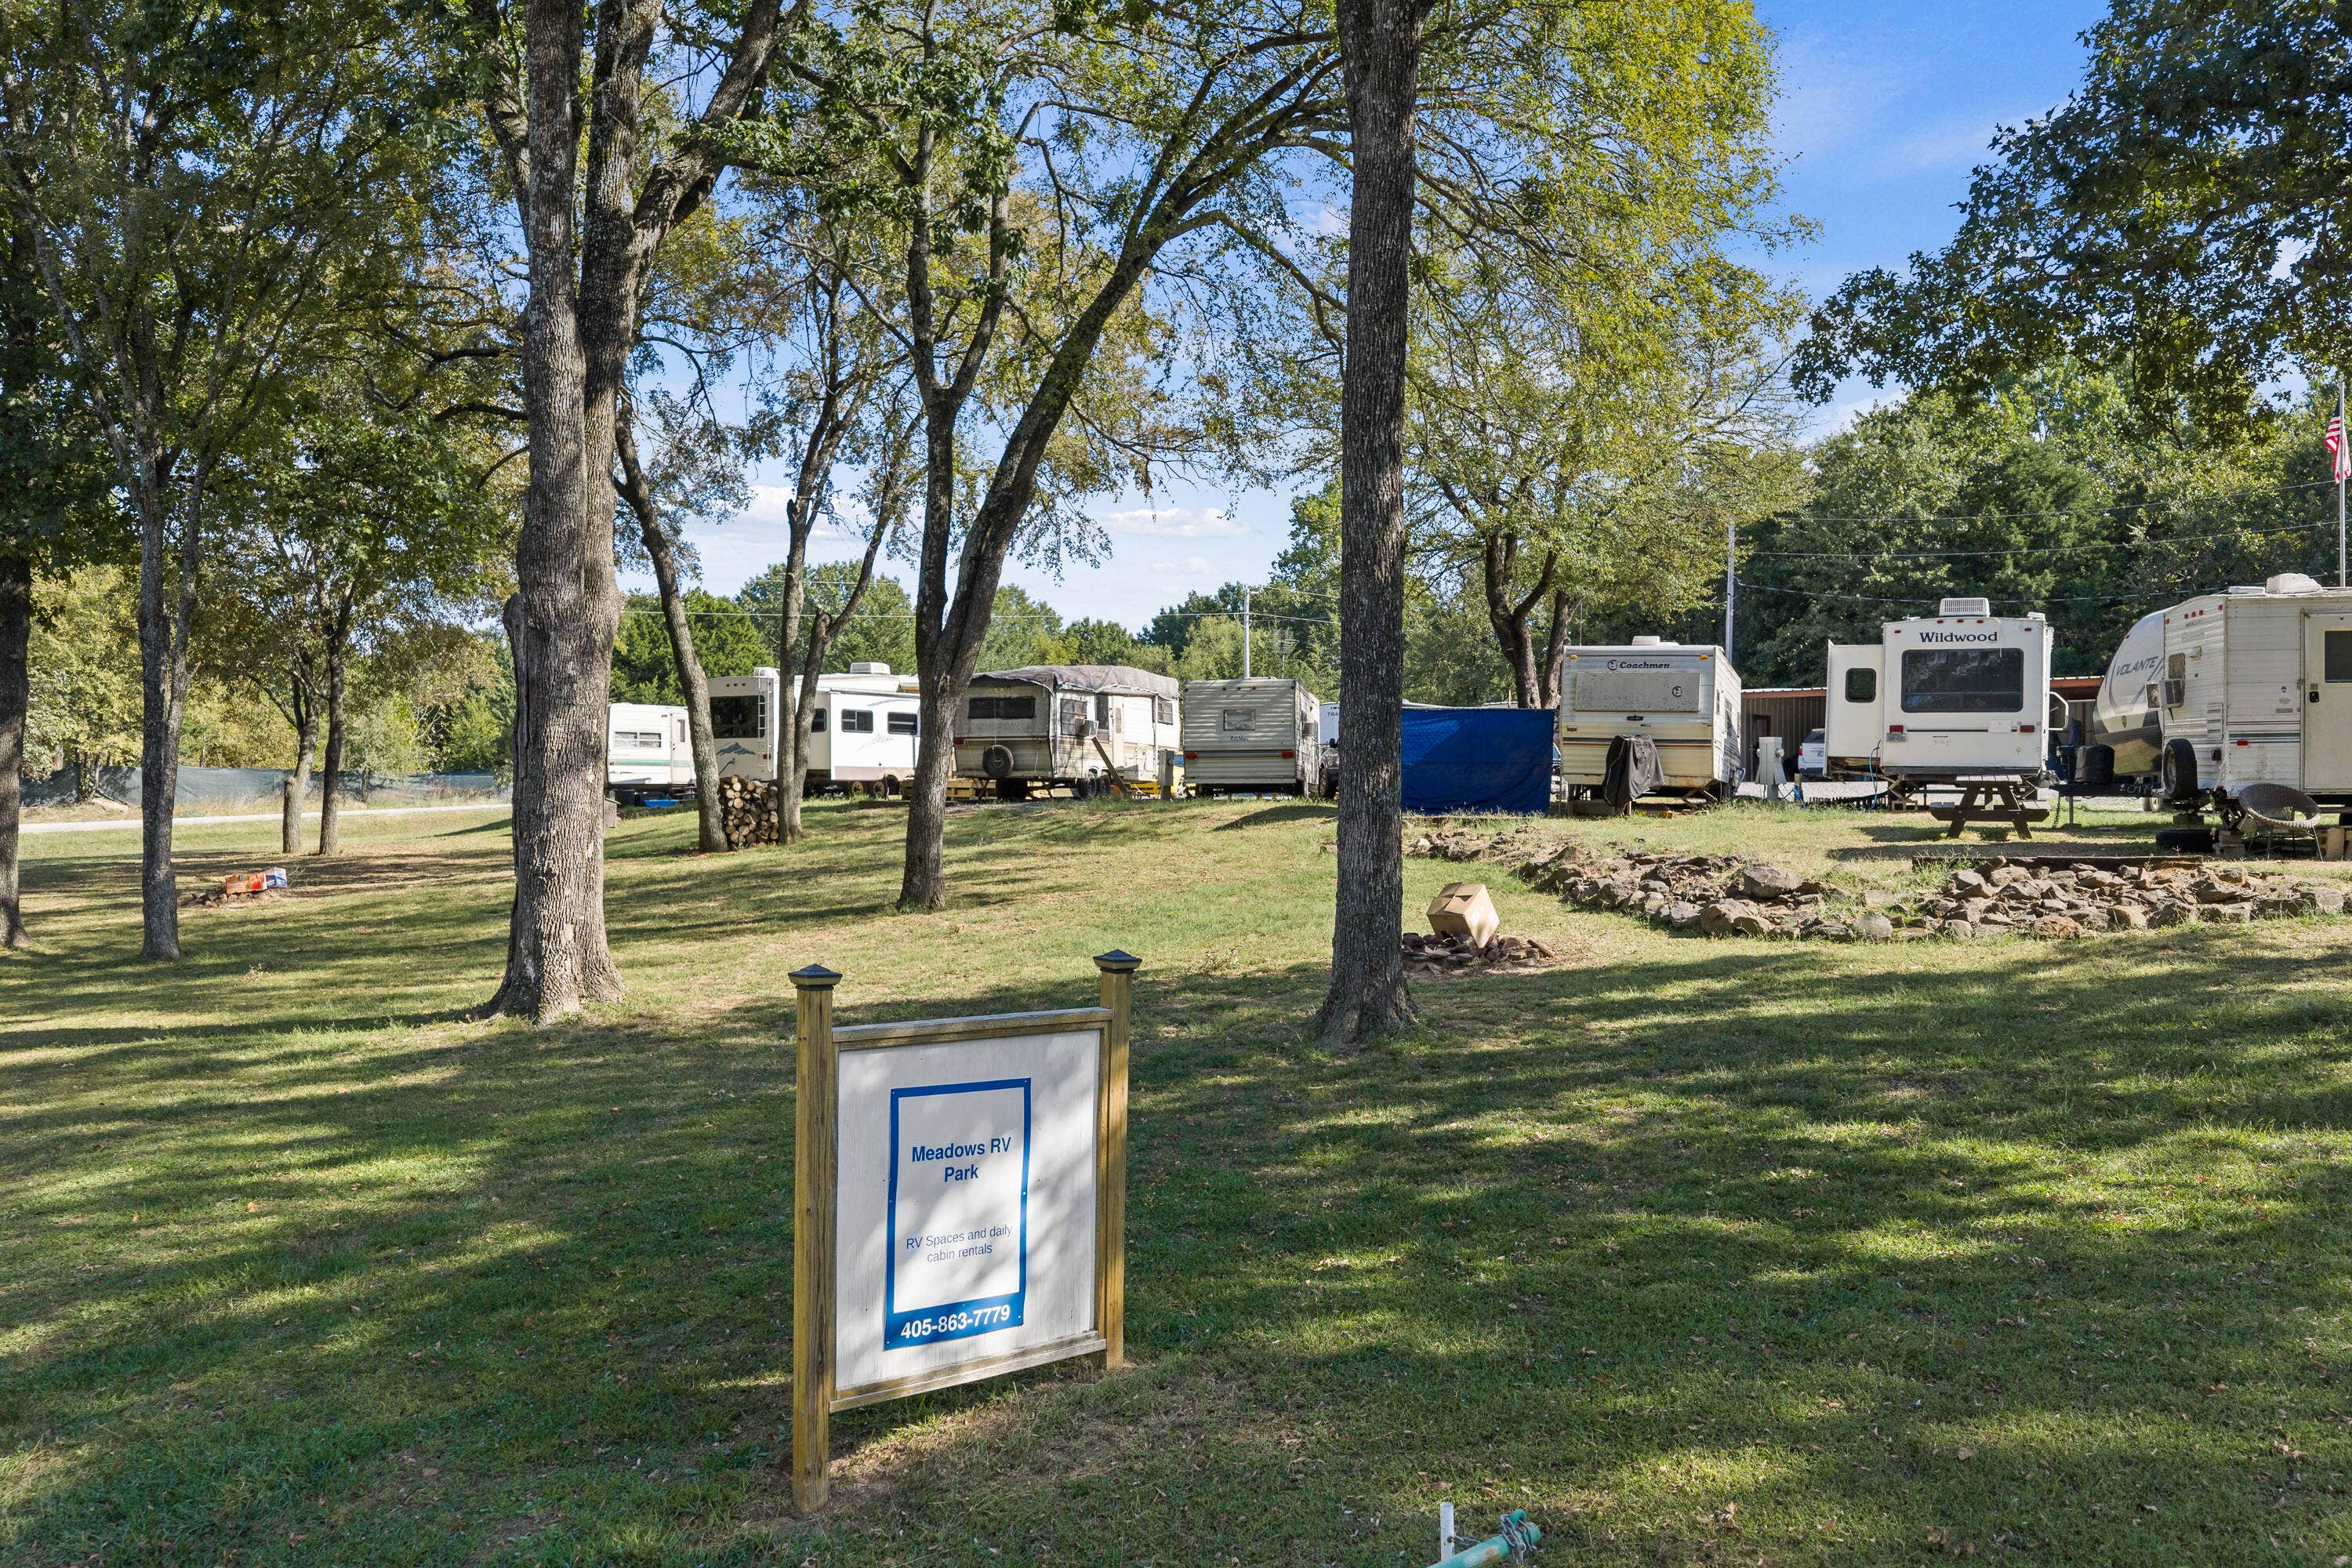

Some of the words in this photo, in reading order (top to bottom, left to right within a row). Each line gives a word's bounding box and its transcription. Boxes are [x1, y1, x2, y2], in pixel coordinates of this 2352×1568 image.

[1919, 631, 1998, 643] Wildwood
[2116, 655, 2159, 677] VOLANTE
[912, 1142, 985, 1163] Meadows
[990, 1137, 1011, 1153] RV
[944, 1163, 979, 1182] Park
[906, 1236, 923, 1249] RV
[926, 1232, 965, 1248] Spaces
[967, 1227, 986, 1240] and
[989, 1224, 1012, 1237] daily
[927, 1250, 955, 1262] cabin
[958, 1243, 993, 1258] rentals
[900, 1304, 1011, 1339] 405-863-7779
